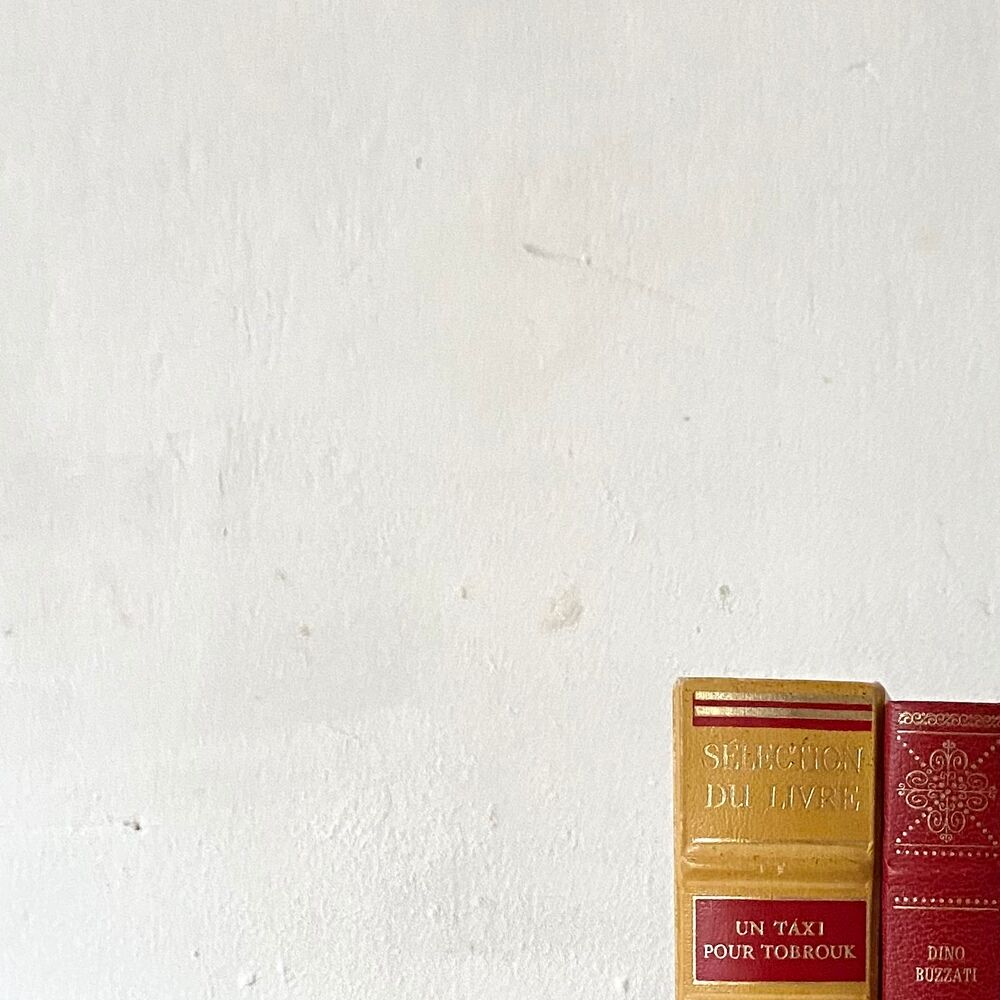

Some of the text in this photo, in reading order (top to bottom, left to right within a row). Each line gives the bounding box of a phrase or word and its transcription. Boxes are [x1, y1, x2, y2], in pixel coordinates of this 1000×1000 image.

[706, 783, 861, 811] DU LIVRE
[736, 920, 764, 936] UN
[704, 944, 856, 960] POUR TOBROUK
[927, 945, 965, 961] DINO
[915, 967, 978, 982] BUZZATI
